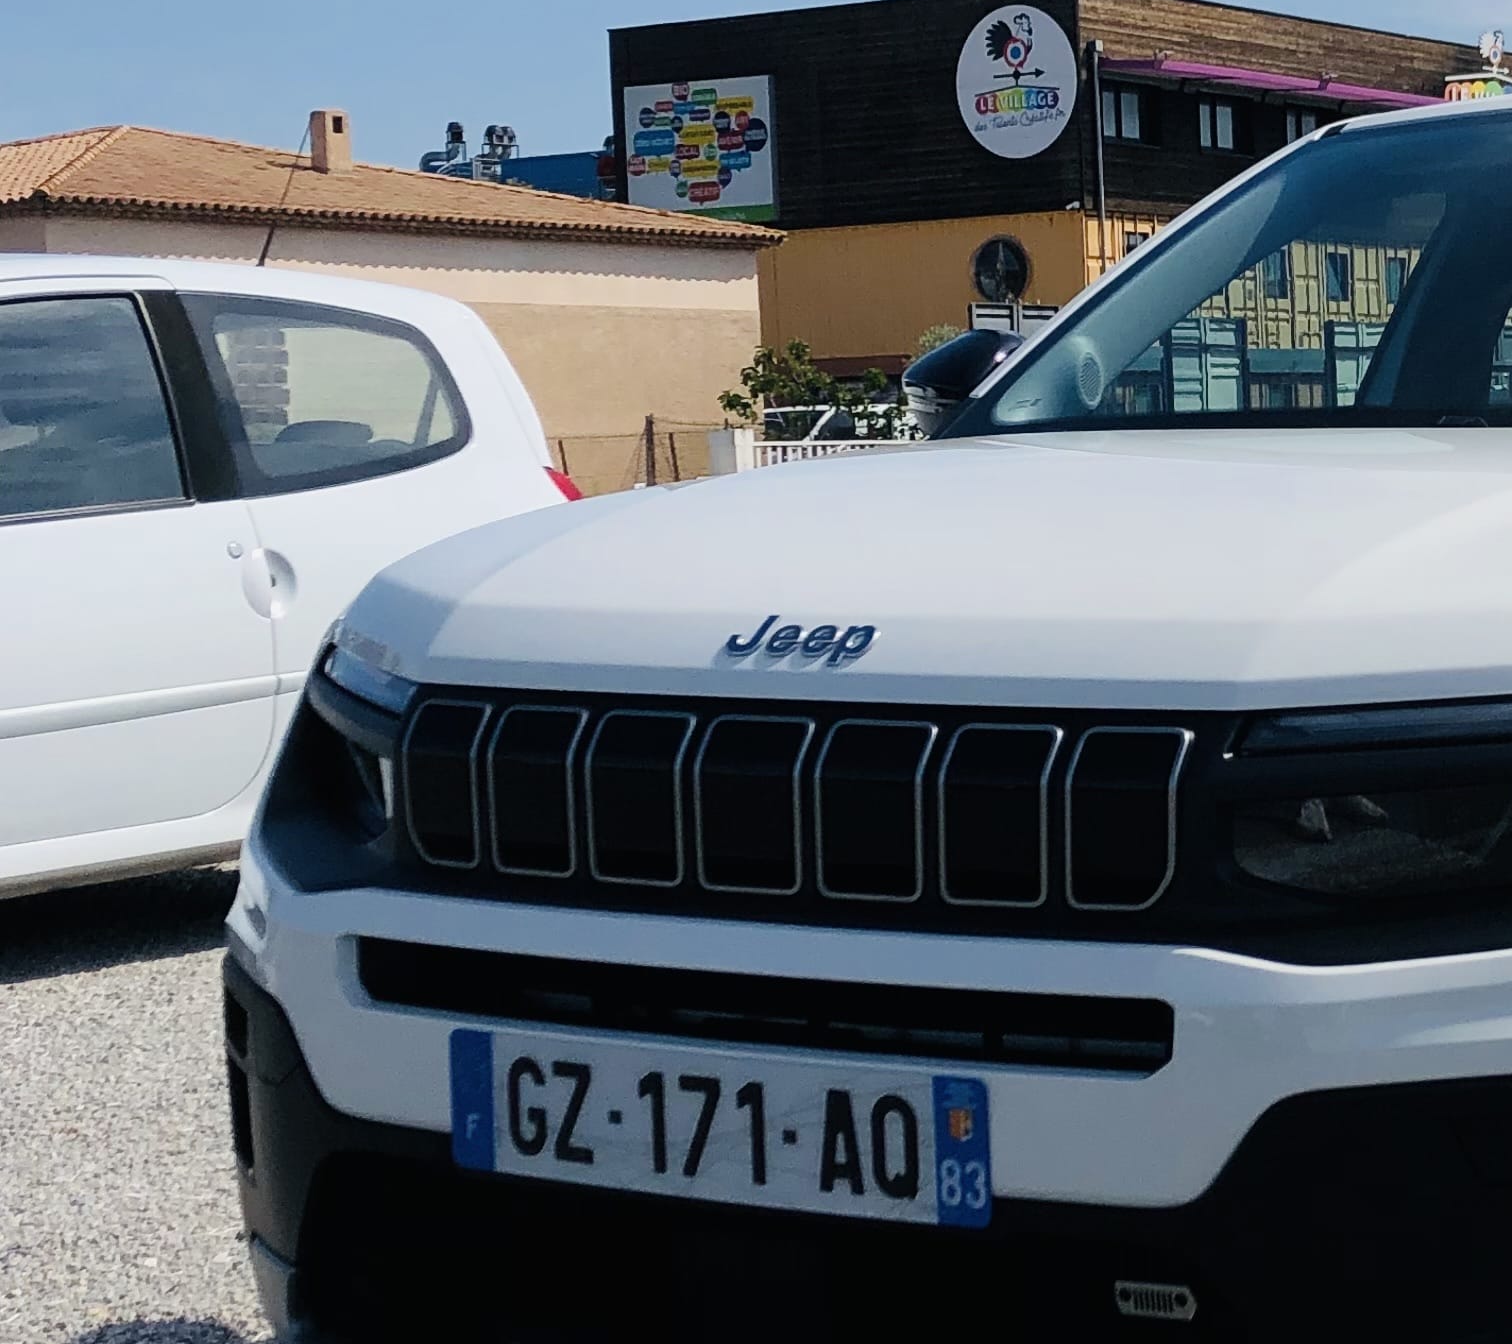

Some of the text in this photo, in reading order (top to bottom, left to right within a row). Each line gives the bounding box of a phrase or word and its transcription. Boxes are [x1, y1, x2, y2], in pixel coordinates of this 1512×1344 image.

[980, 91, 1055, 112] LE VILLAGE
[725, 614, 877, 667] Jeep
[465, 1112, 480, 1140] F
[940, 1159, 986, 1209] 83
